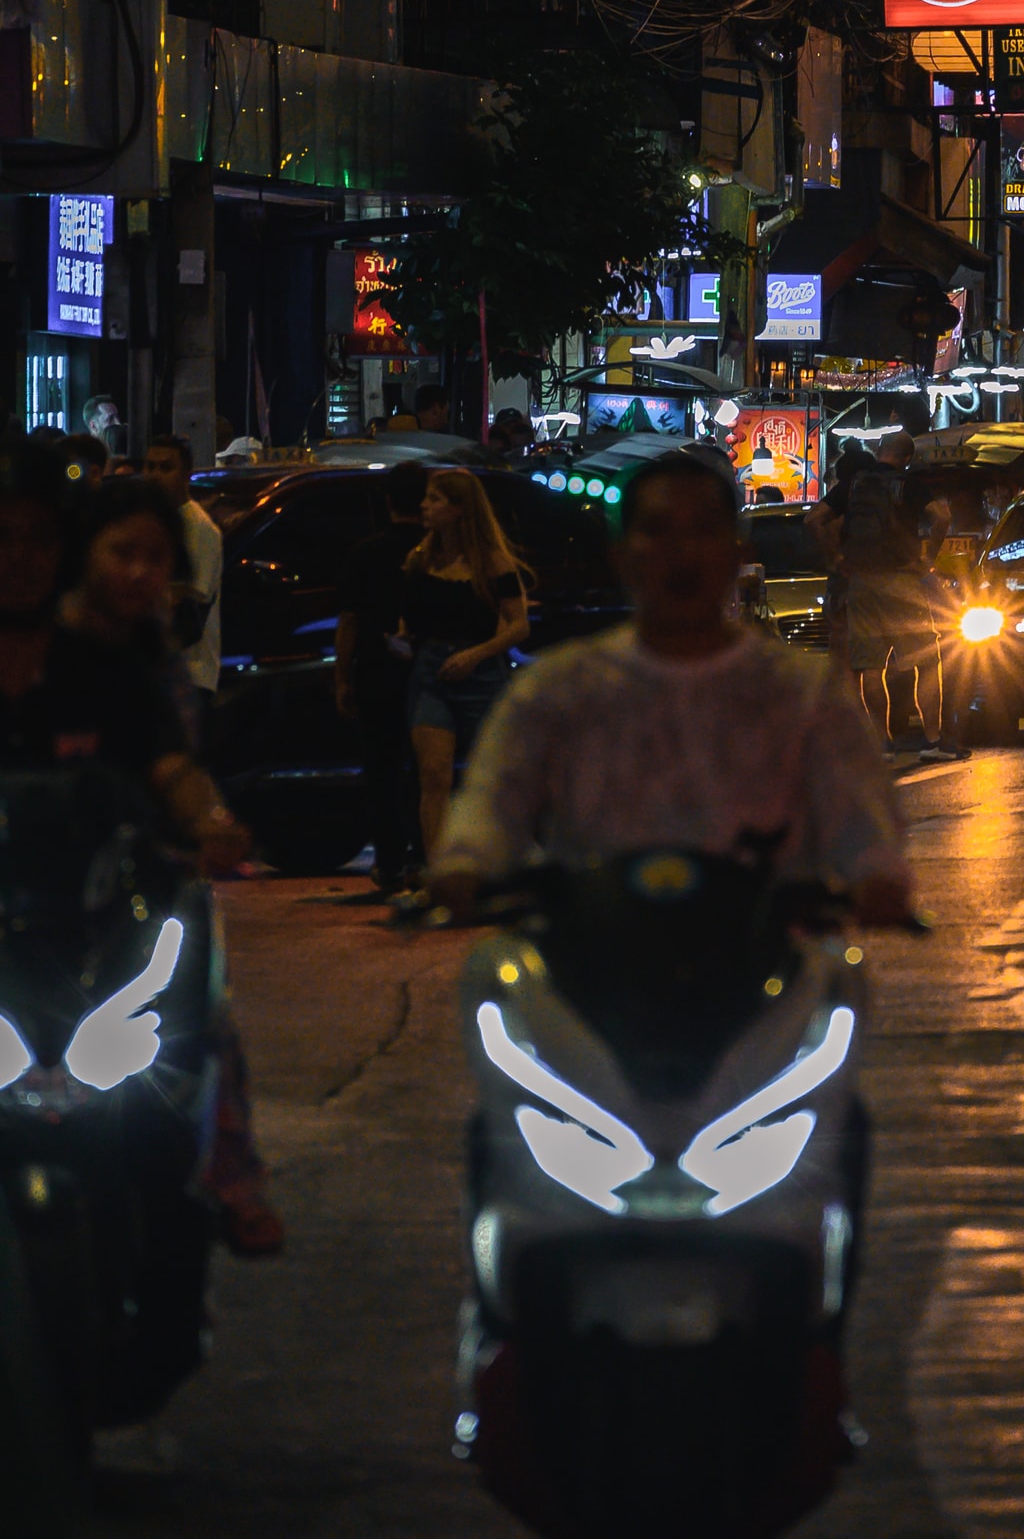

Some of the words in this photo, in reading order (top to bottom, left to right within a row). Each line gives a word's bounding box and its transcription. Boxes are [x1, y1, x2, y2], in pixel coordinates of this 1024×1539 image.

[767, 281, 816, 310] Boots
[797, 325, 816, 336] ยา
[933, 449, 965, 459] TAXI
